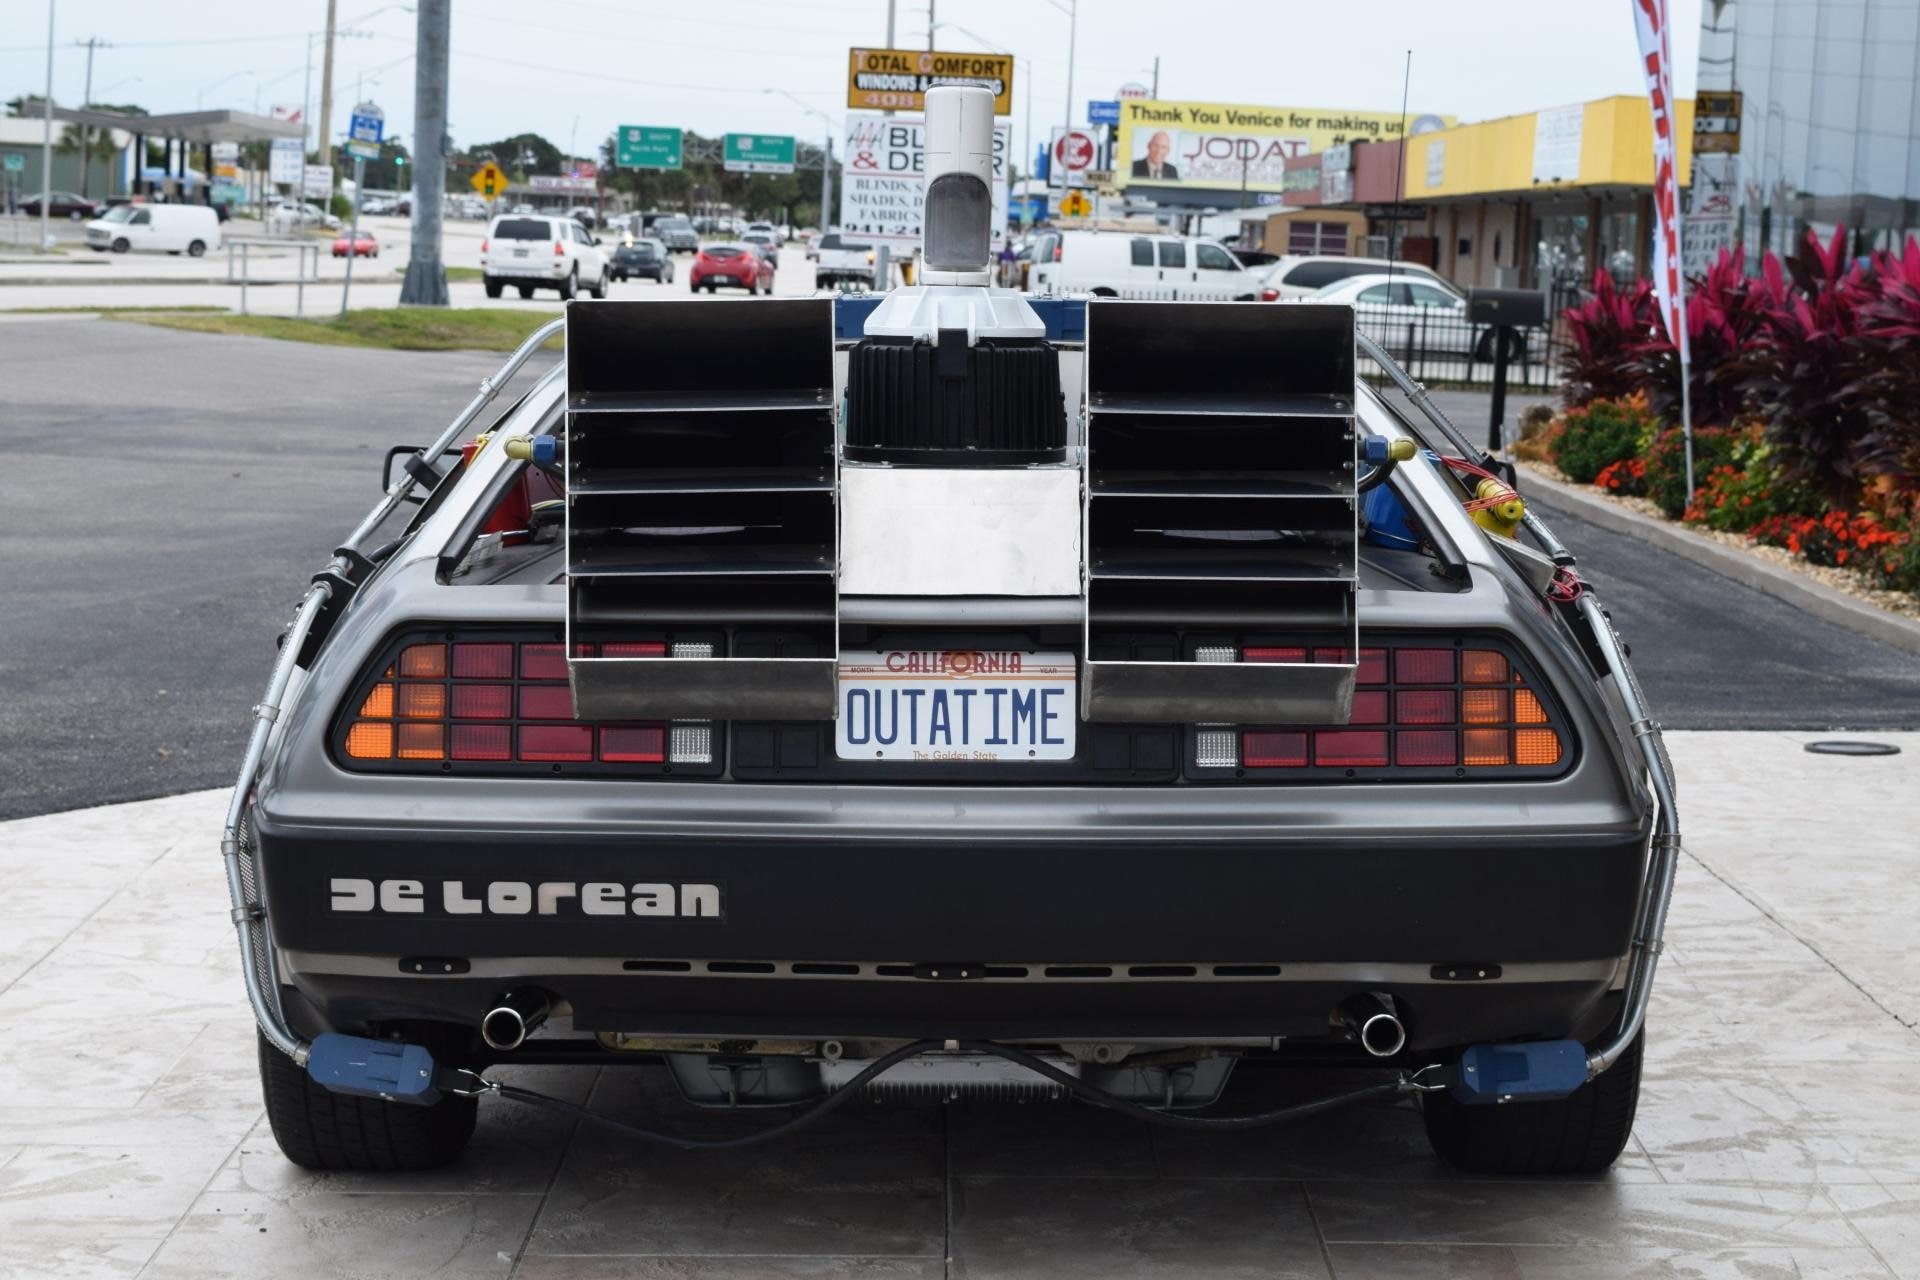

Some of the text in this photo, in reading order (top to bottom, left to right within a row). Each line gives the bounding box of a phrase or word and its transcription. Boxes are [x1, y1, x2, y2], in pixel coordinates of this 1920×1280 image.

[855, 50, 1006, 75] TOTAL COMFORT
[857, 73, 917, 91] WINDOWS
[1130, 104, 1184, 122] Thank
[1189, 108, 1220, 124] You
[1225, 110, 1283, 127] Venice
[1289, 113, 1311, 128] for
[1317, 114, 1380, 135] making
[1385, 121, 1404, 134] us
[852, 151, 880, 170] &
[1183, 137, 1306, 162] JODAT
[886, 651, 1022, 673] CALIFORNIA
[847, 688, 1065, 745] OUTATIME
[913, 751, 998, 760] The Golden State
